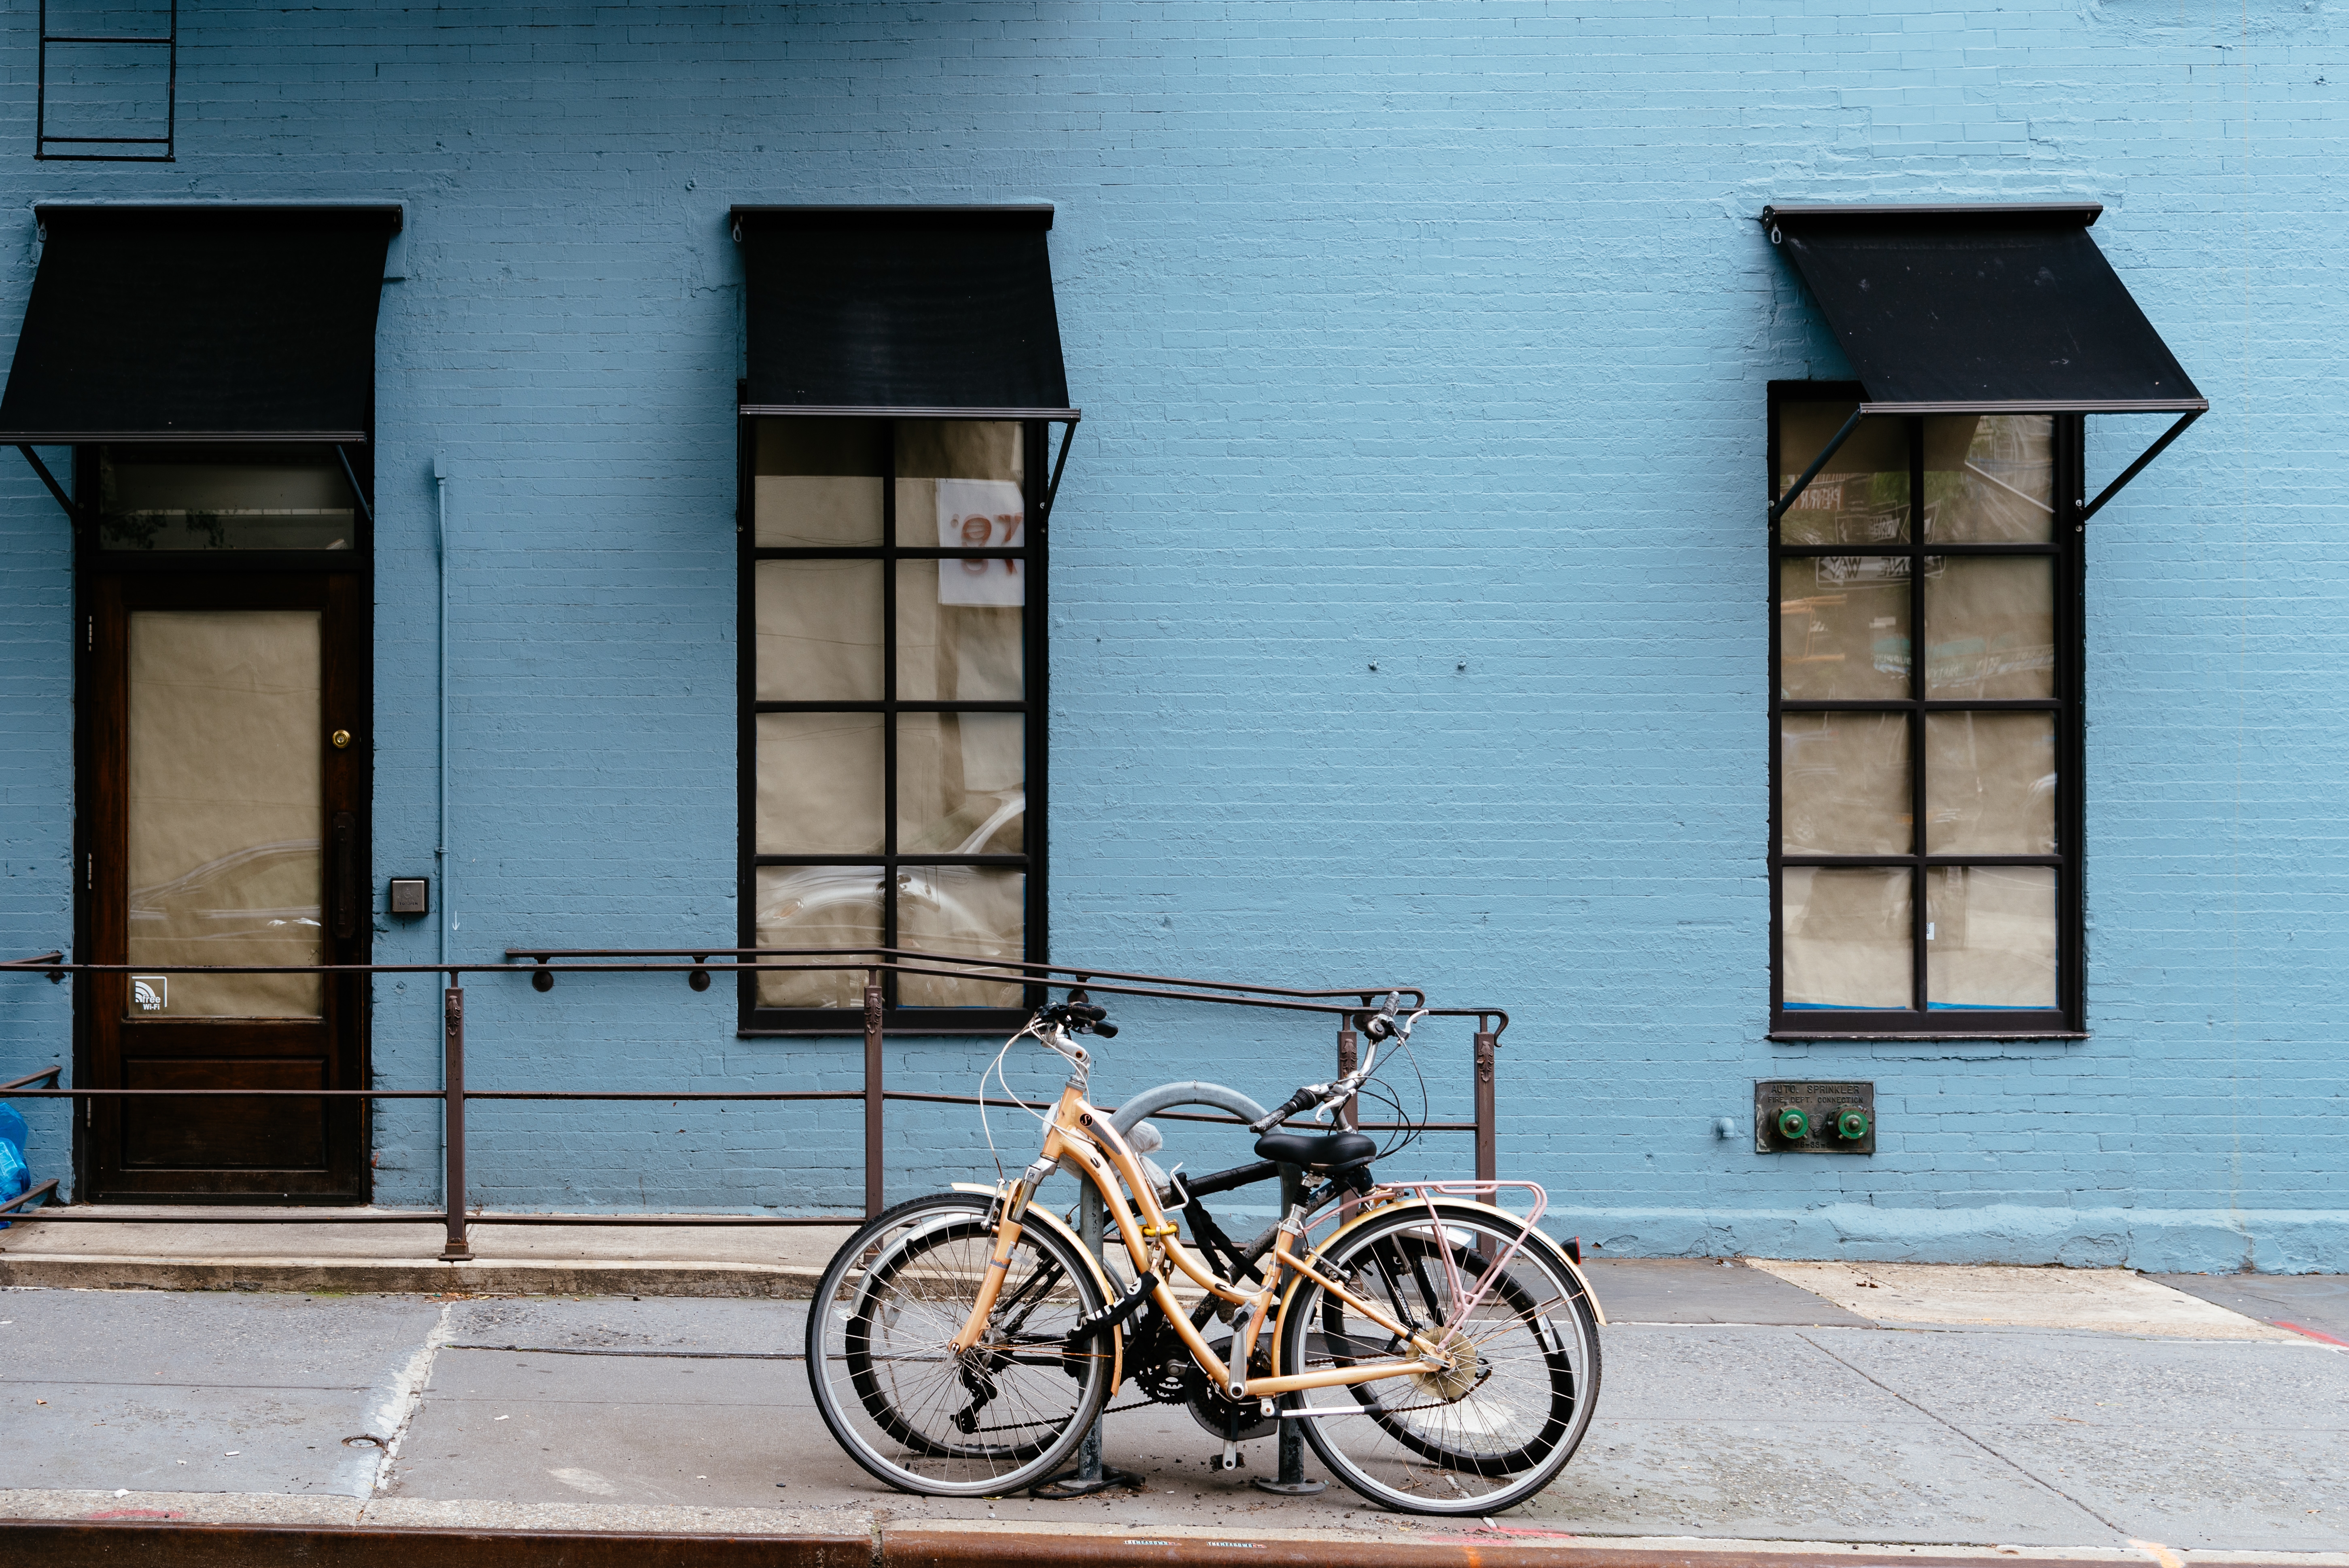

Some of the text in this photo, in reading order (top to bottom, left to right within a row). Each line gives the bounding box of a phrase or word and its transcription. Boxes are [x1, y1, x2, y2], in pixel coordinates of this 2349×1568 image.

[142, 994, 161, 1003] free
[1771, 1084, 1859, 1094] AUTO. SPRINKLER
